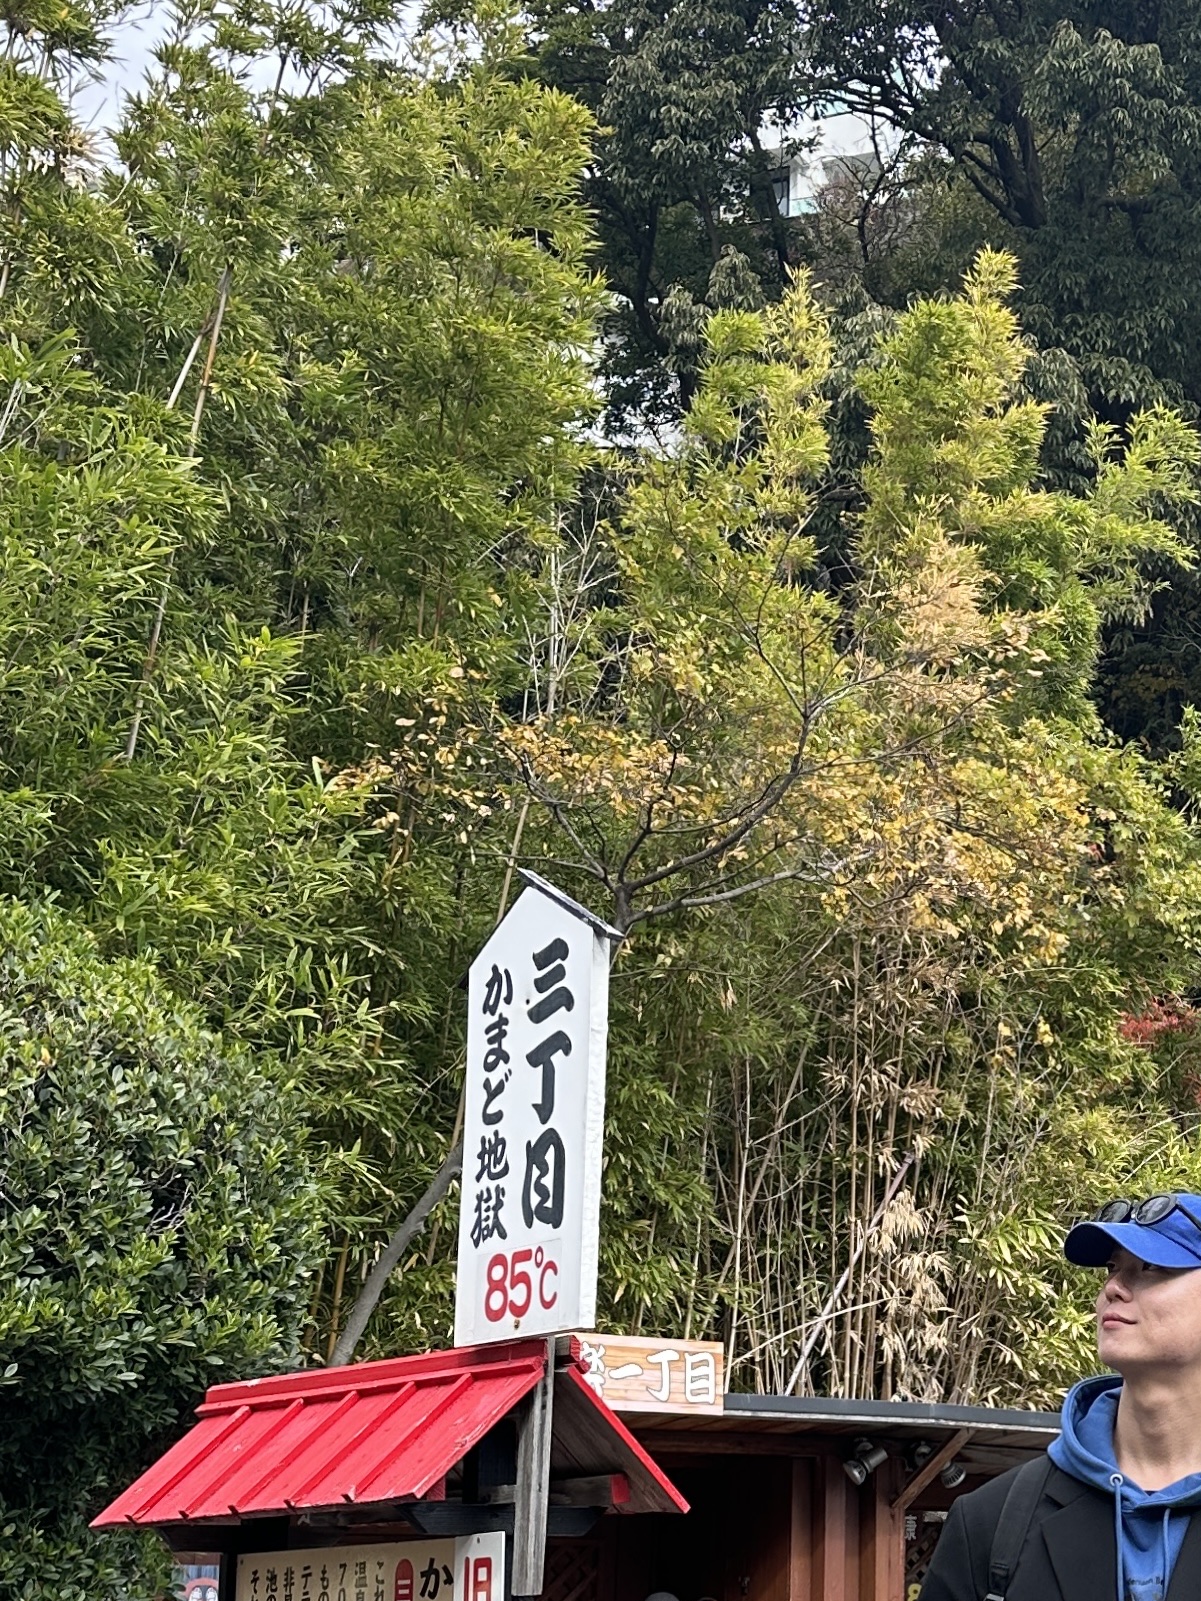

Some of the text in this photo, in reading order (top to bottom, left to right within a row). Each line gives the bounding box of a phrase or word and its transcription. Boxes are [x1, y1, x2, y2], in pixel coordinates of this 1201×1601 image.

[470, 964, 513, 1249] かまど地獄
[521, 937, 574, 1229] 三丁目
[580, 1341, 716, 1405] 楽一丁目
